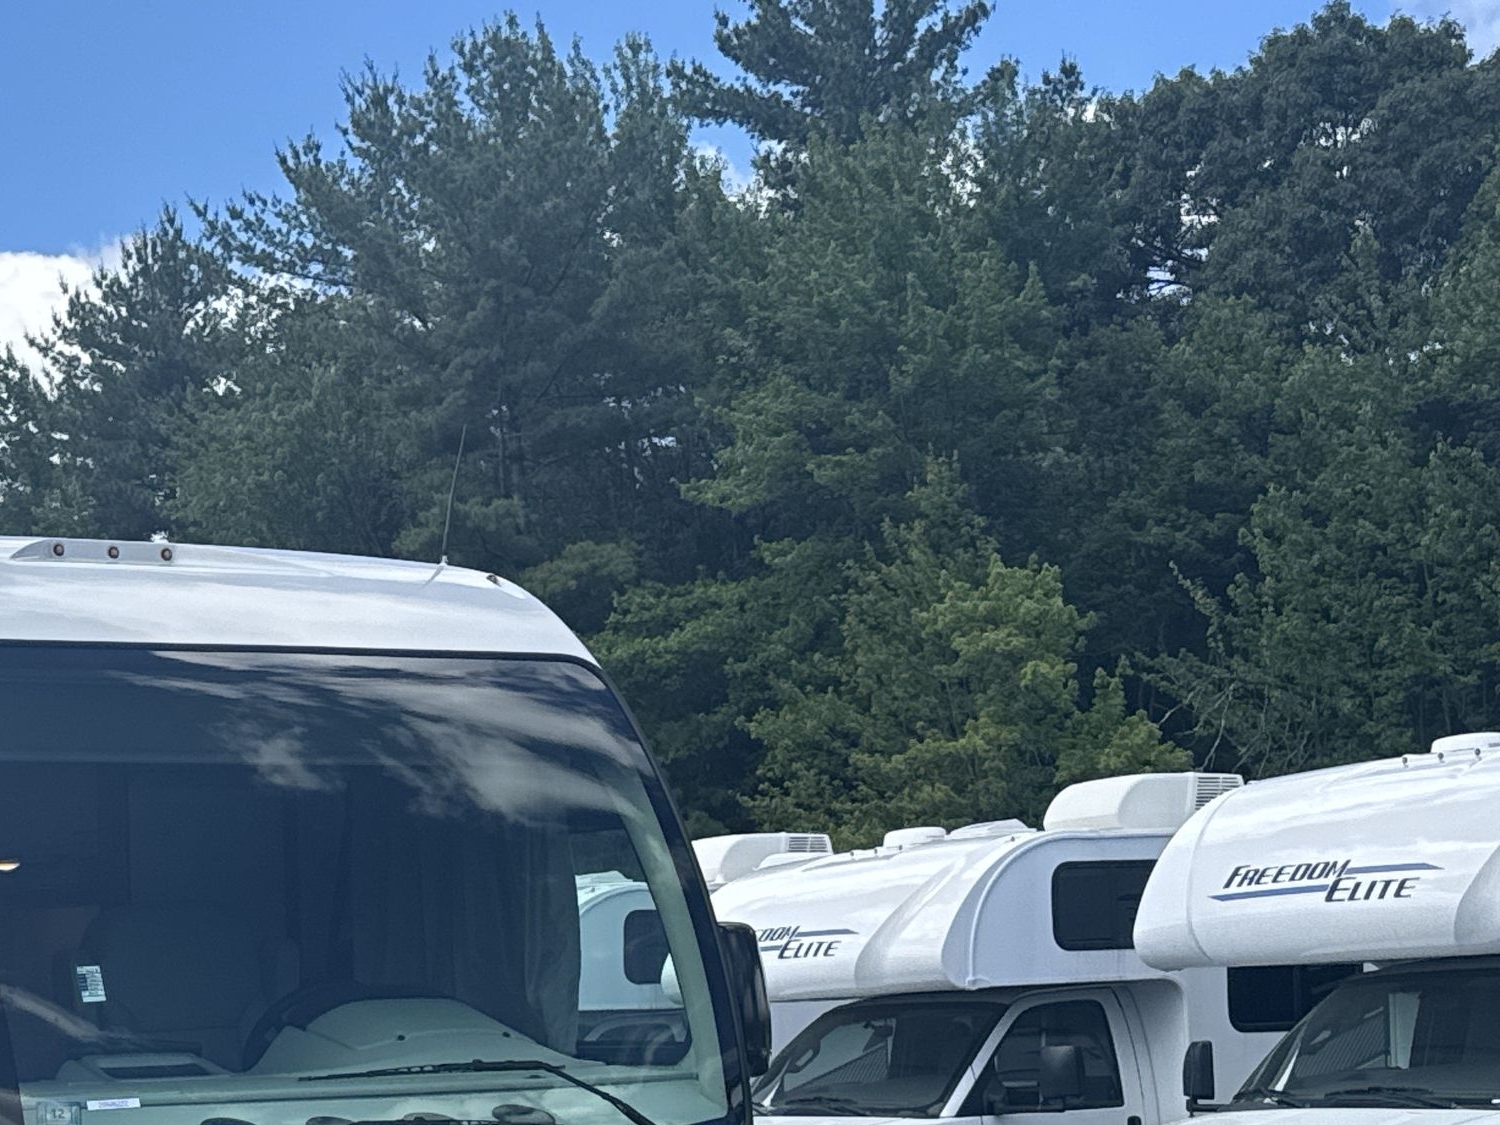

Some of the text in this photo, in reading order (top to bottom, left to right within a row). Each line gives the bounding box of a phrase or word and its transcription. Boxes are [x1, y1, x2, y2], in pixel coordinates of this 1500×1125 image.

[1222, 859, 1352, 889] FREEDOM
[1324, 877, 1421, 903] ELITE
[777, 939, 842, 960] ELITE
